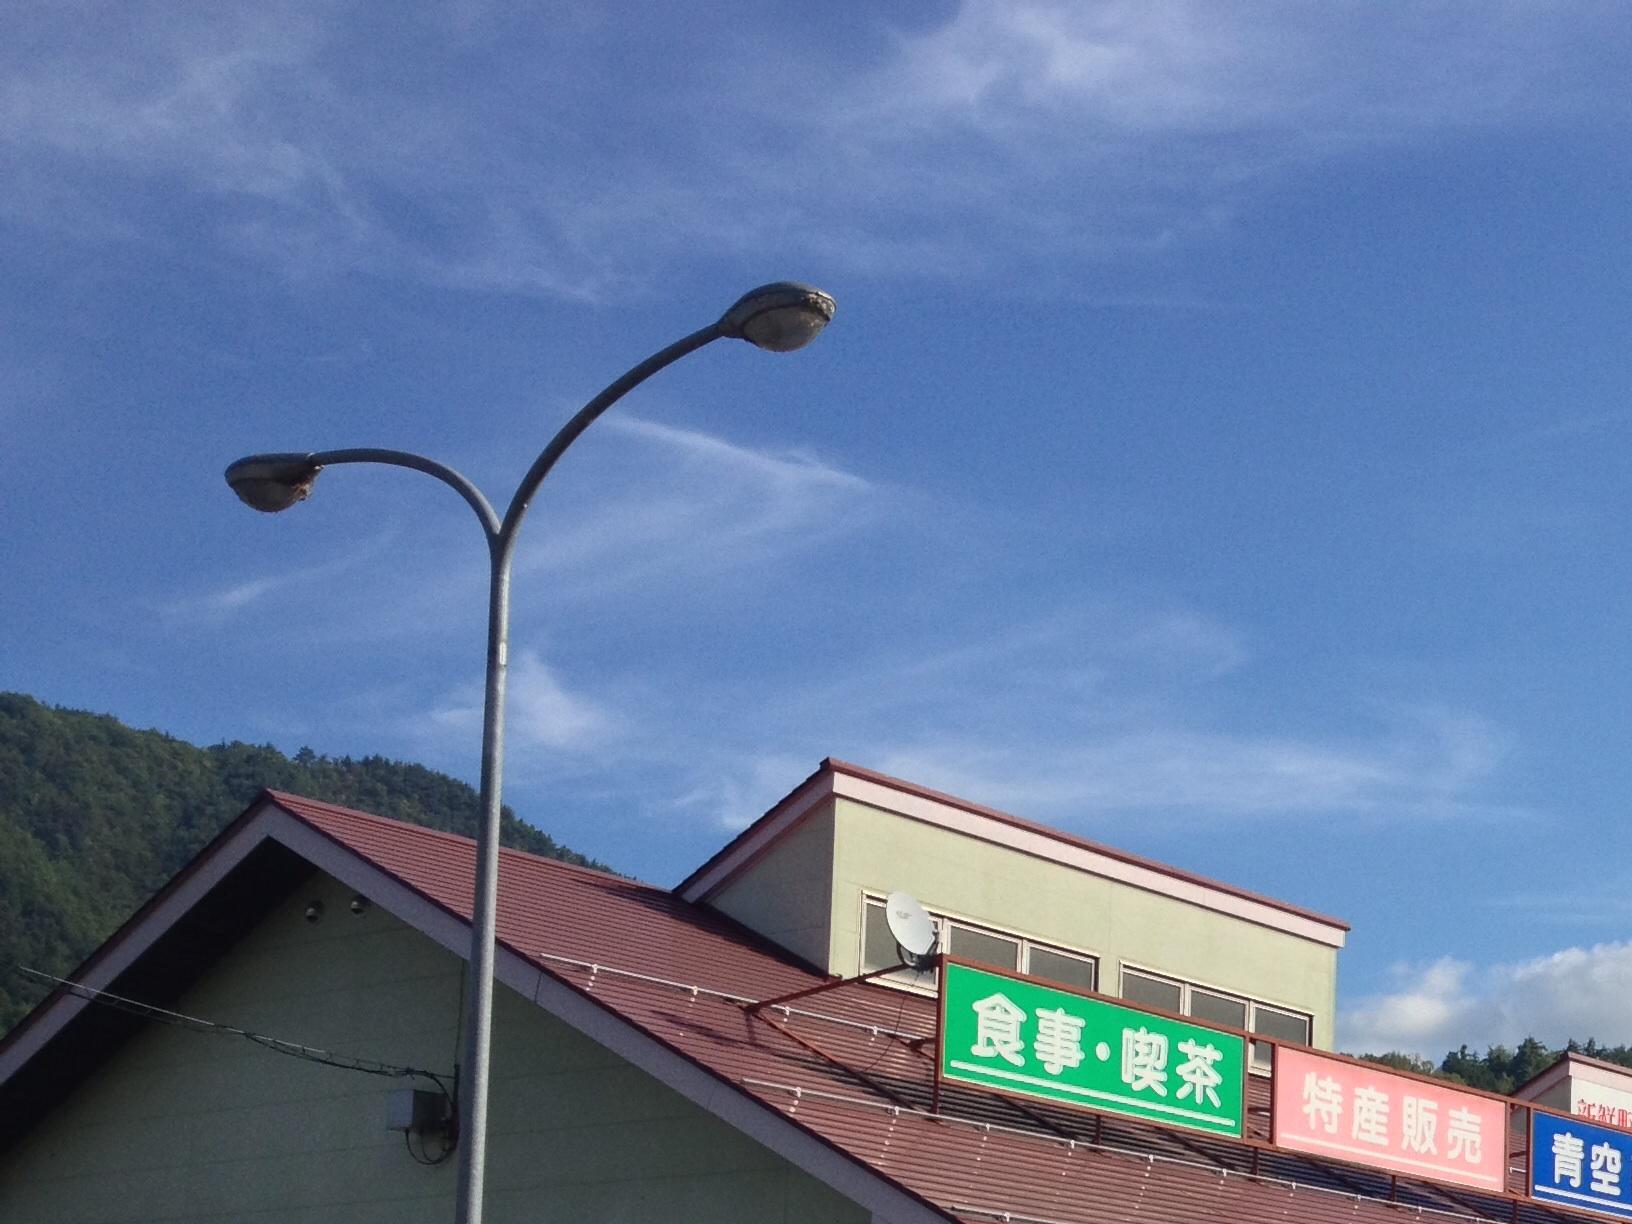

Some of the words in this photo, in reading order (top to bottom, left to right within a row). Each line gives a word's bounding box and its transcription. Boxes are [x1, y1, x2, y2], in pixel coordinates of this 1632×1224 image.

[970, 992, 1223, 1109] 食事・喫茶
[1302, 1071, 1482, 1165] 特産販売
